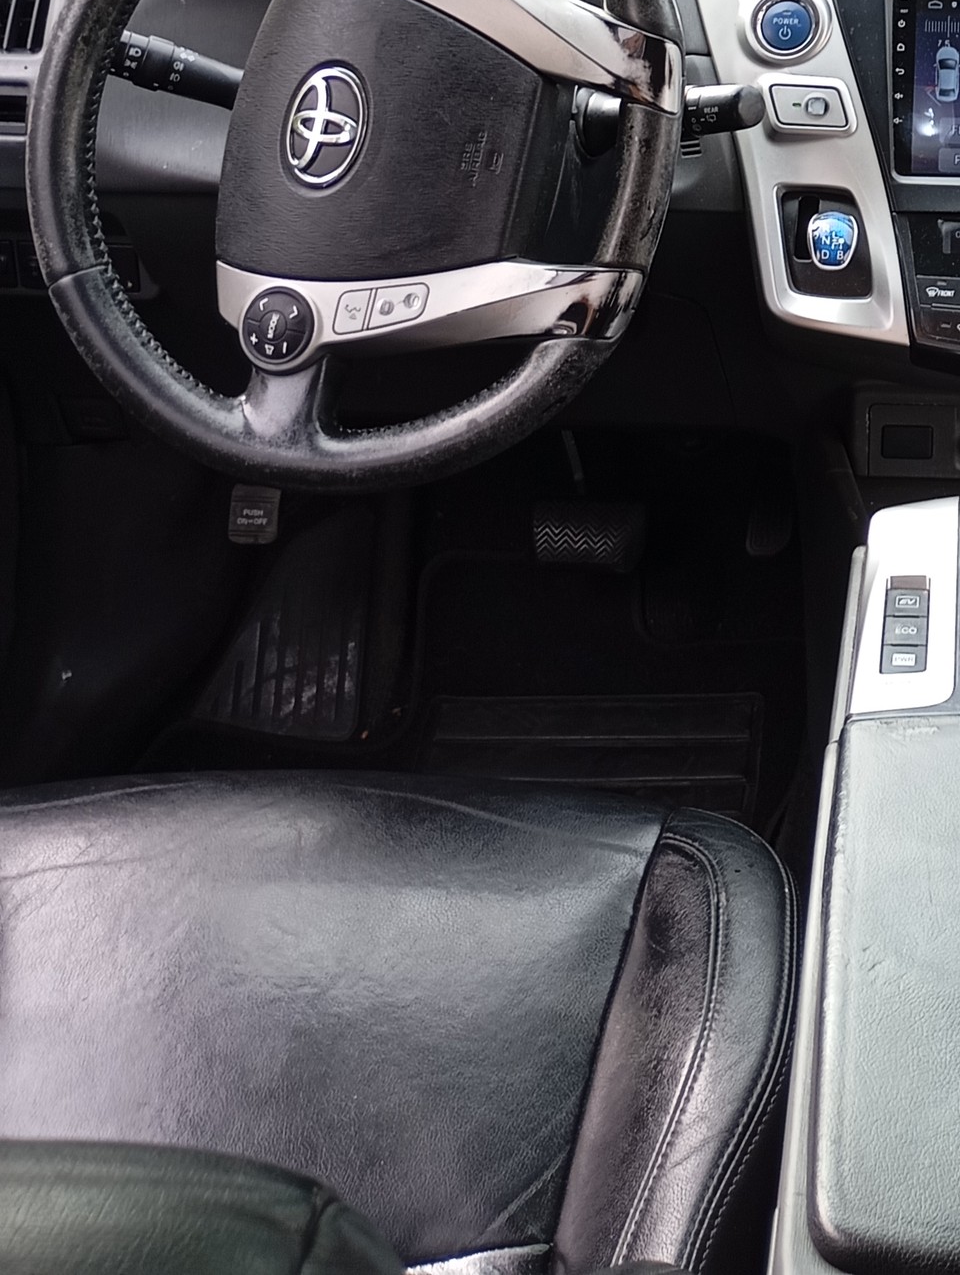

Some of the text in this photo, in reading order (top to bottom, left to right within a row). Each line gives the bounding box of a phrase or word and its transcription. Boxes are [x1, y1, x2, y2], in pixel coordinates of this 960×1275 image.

[772, 17, 799, 25] POWER
[821, 236, 830, 245] N
[821, 249, 830, 260] D
[836, 250, 844, 261] B
[937, 289, 955, 298] FRONT
[243, 508, 264, 517] PUSH
[894, 625, 918, 635] ECO
